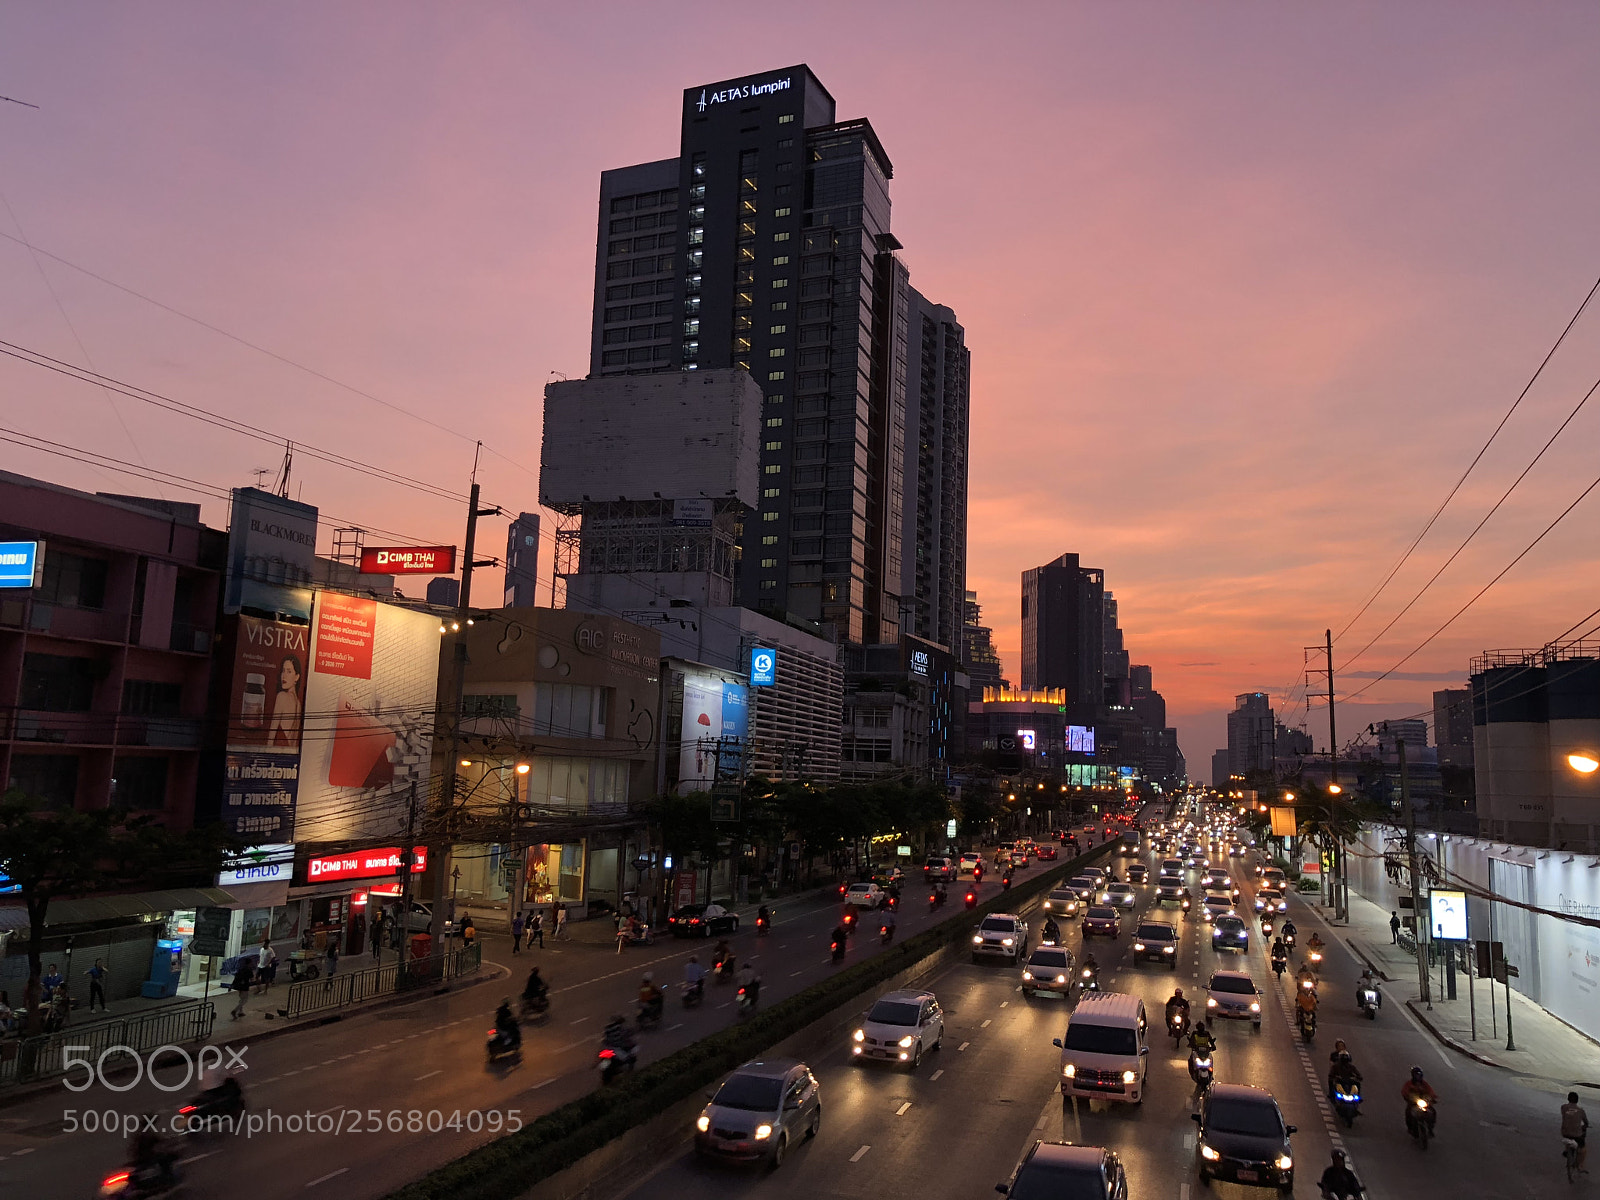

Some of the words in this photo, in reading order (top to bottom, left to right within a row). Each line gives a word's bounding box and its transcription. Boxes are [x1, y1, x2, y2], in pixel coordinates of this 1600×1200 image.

[710, 86, 749, 105] AETAS
[751, 77, 791, 96] lumpini
[250, 519, 316, 547] BLACKMORES
[389, 552, 413, 562] CIMB
[414, 552, 435, 562] THAI
[246, 622, 306, 652] VISTRA
[578, 628, 604, 648] AIC
[914, 651, 928, 664] AETAS
[322, 860, 341, 872] CIMB
[342, 860, 358, 870] THAI
